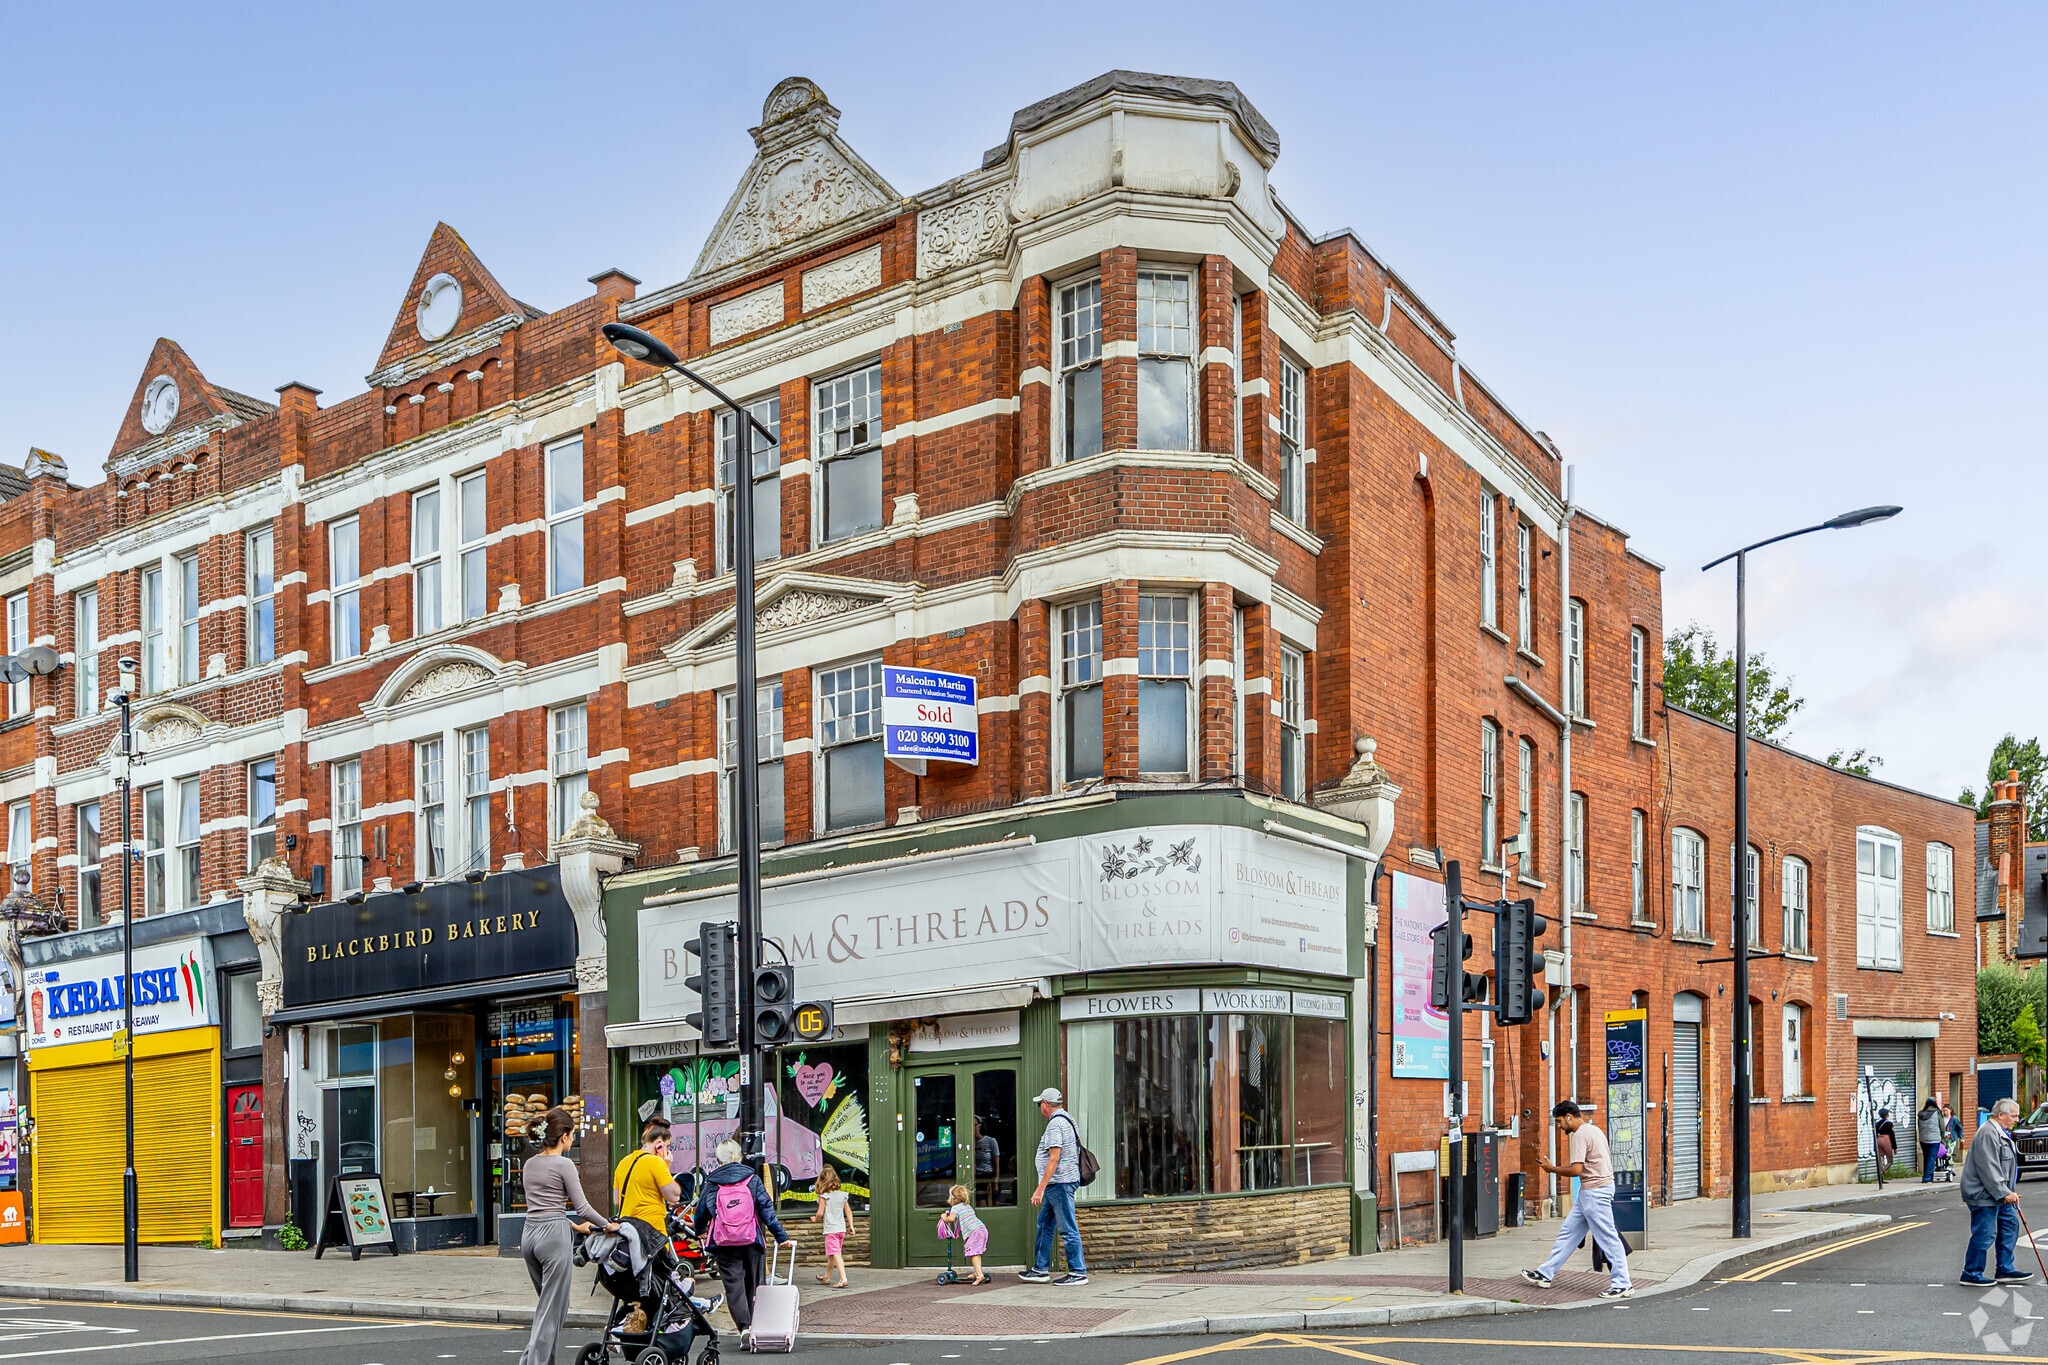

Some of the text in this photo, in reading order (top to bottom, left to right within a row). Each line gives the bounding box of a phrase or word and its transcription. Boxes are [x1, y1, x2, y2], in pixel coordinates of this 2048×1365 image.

[896, 674, 966, 691] Malcolm Martin
[896, 686, 922, 695] Chartered
[917, 704, 952, 723] Sold
[897, 730, 969, 747] 020 8690 3100
[1101, 880, 1200, 901] BLOSSOM
[1236, 863, 1340, 900] BLOSSOM & THREADS
[1142, 900, 1158, 918] &
[1104, 920, 1202, 940] THREADS
[1395, 917, 1403, 926] THE
[307, 909, 540, 963] BLACKBIRD BAKERY
[663, 896, 1049, 980] BLOM & THREADS
[1395, 930, 1406, 940] CAKE
[1407, 933, 1419, 943] STORE
[1088, 995, 1173, 1014] FLOWERS
[1213, 992, 1286, 1009] WORKSHOPS
[1296, 997, 1341, 1011] WEDDING FLORIST
[68, 1021, 113, 1037] RESTAURANT
[116, 1020, 121, 1030] &
[510, 1010, 538, 1029] 109
[800, 1011, 822, 1032] 05
[960, 1027, 968, 1038] &
[970, 1025, 1010, 1036] THREADS
[638, 1041, 689, 1059] FLOWERS
